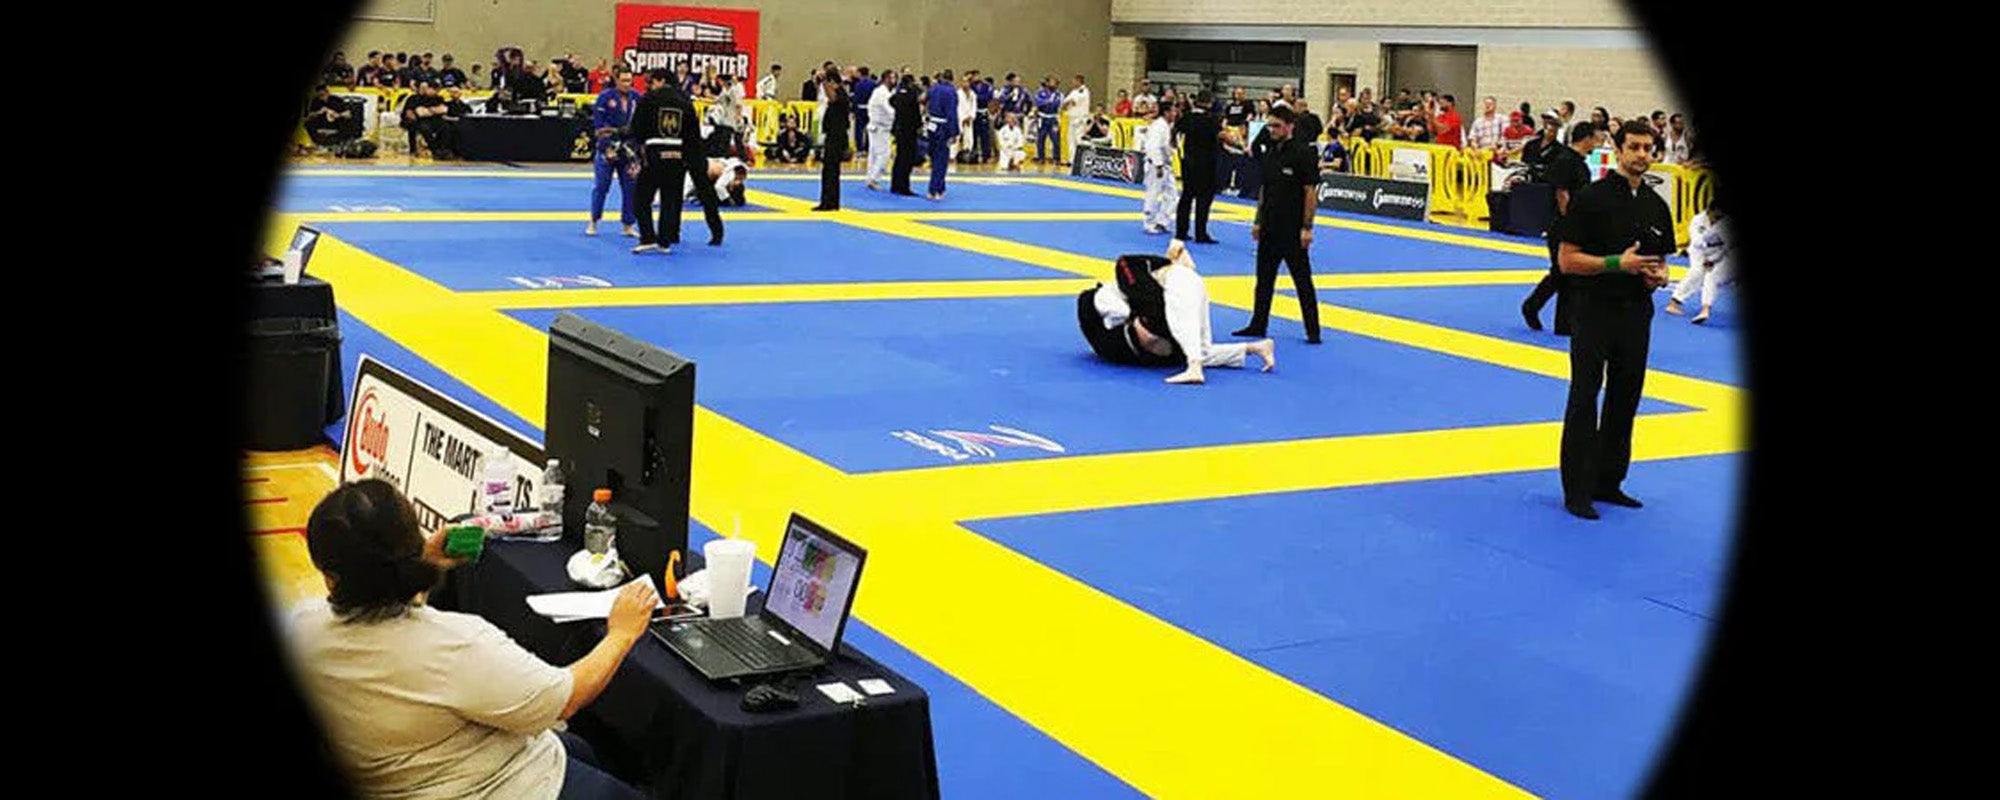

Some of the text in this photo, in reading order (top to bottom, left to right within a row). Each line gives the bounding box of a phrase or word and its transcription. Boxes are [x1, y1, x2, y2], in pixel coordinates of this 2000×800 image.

[624, 49, 748, 79] SPORTS CENTER
[422, 421, 445, 460] THE
[443, 434, 483, 481] MART
